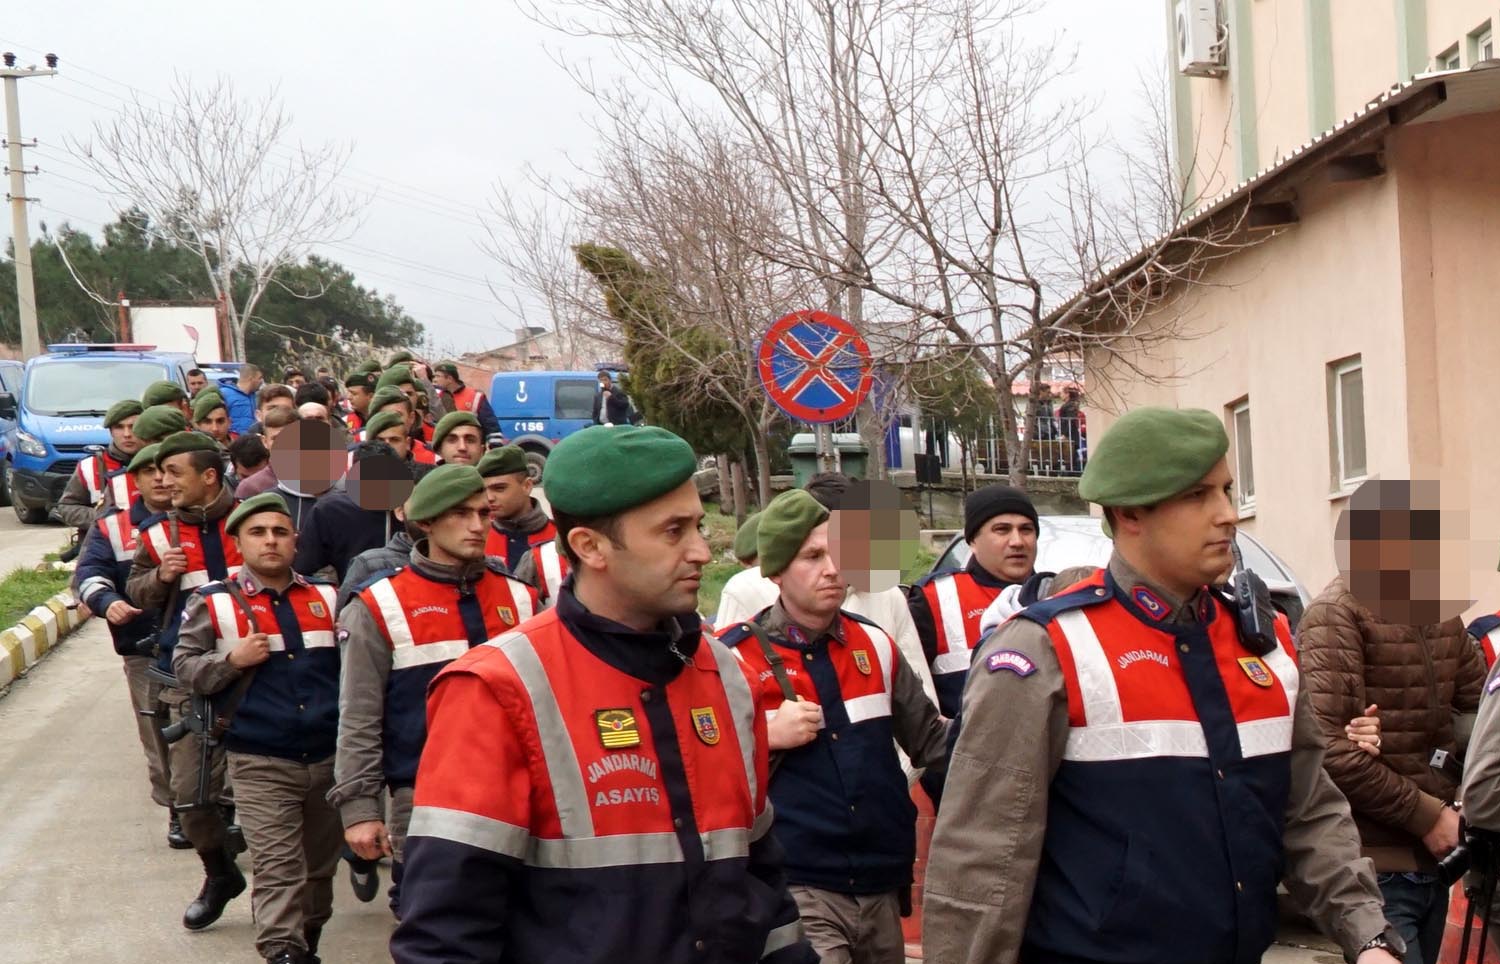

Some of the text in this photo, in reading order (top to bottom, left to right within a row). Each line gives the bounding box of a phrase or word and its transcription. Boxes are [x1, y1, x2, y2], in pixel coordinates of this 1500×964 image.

[55, 423, 107, 433] JANDA
[521, 421, 545, 432] 156
[1117, 650, 1169, 669] JANDARMA
[759, 667, 798, 682] JANMA
[587, 753, 657, 784] JANDARMA
[595, 786, 660, 807] ASAYİŞ
